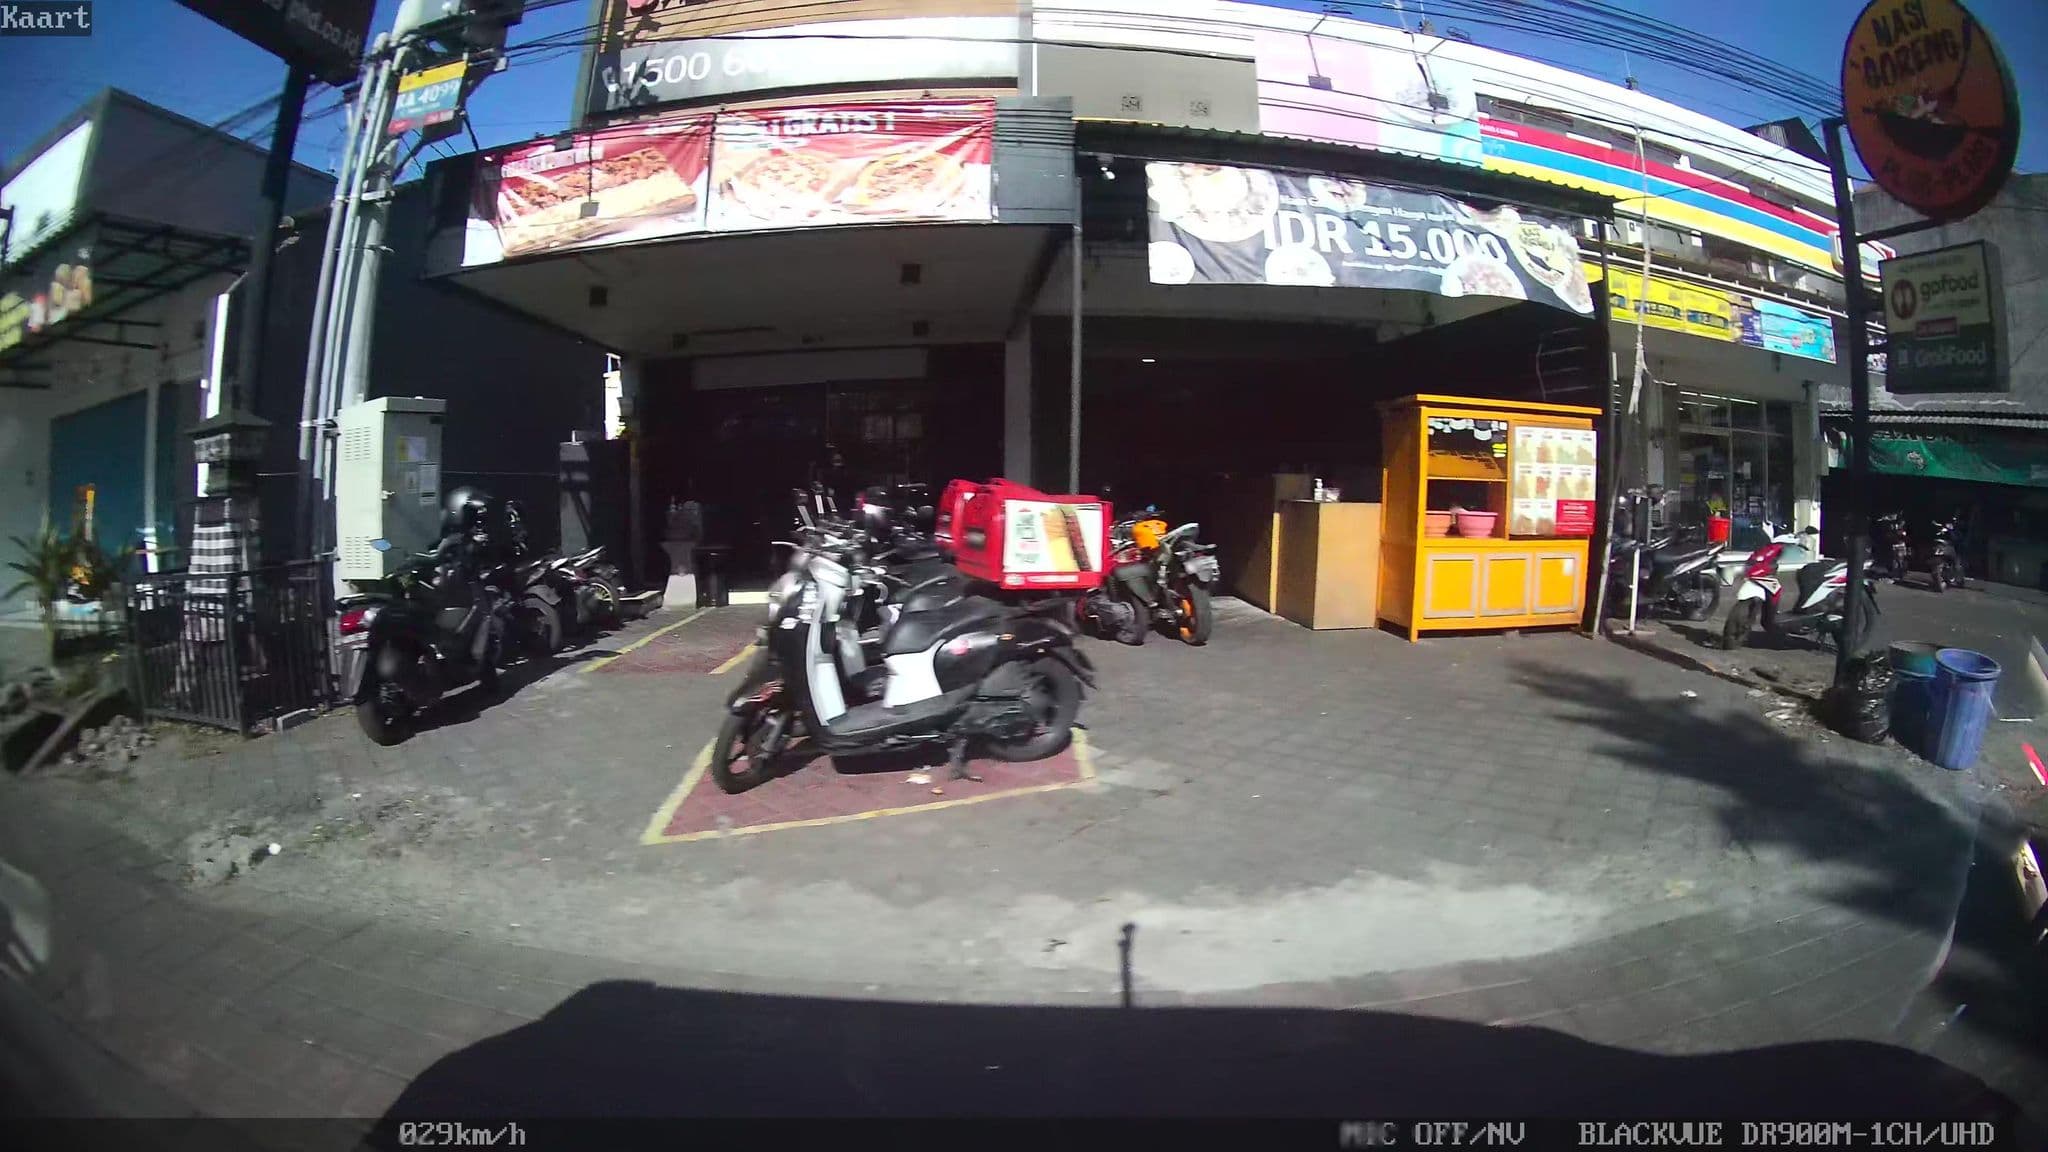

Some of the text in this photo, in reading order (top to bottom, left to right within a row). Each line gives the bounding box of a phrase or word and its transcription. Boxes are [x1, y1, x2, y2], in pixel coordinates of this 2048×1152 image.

[1871, 0, 1928, 47] NASI
[622, 51, 712, 88] 1500
[1264, 209, 1354, 254] IDR
[1364, 220, 1509, 265] 15.000
